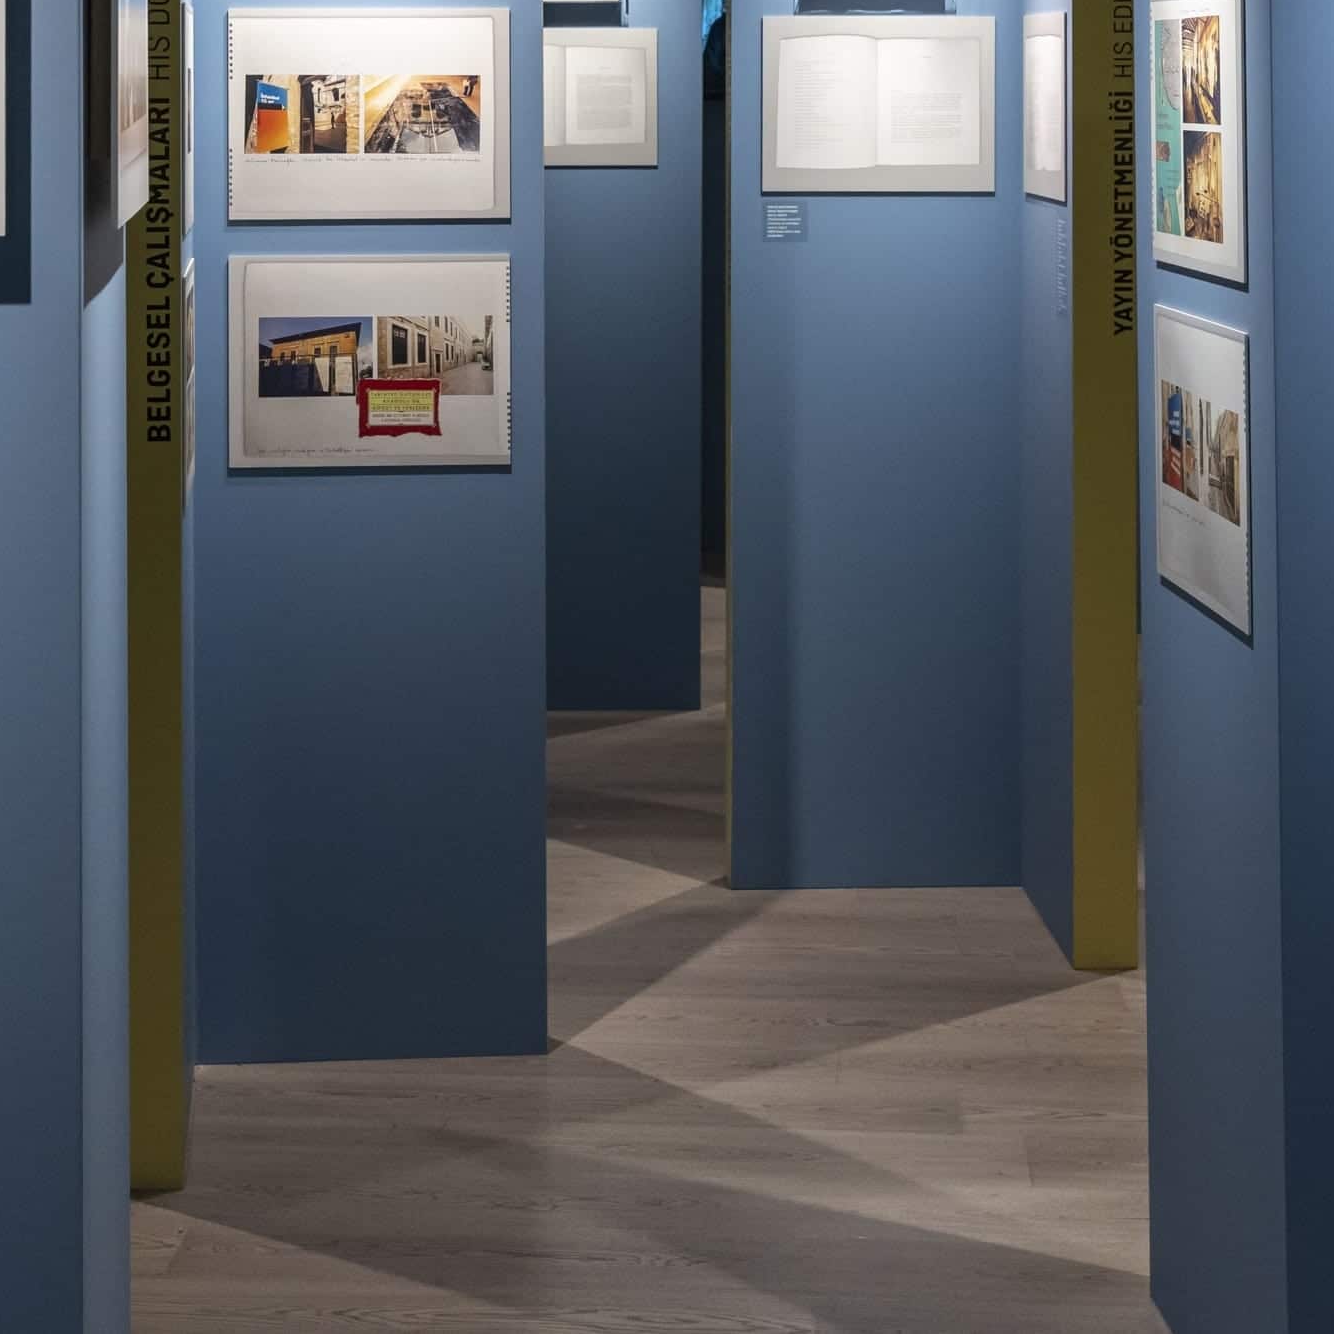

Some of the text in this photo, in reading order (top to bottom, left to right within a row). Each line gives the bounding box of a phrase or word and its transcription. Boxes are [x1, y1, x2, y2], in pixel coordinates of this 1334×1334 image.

[147, 36, 171, 80] HIS
[1113, 40, 1133, 78] HIS
[146, 96, 175, 288] ÇALIŞMALARI
[1107, 90, 1134, 263] YÖNETMENLİĞİ
[1113, 269, 1134, 337] YAYIN
[146, 295, 171, 443] BELGESEL
